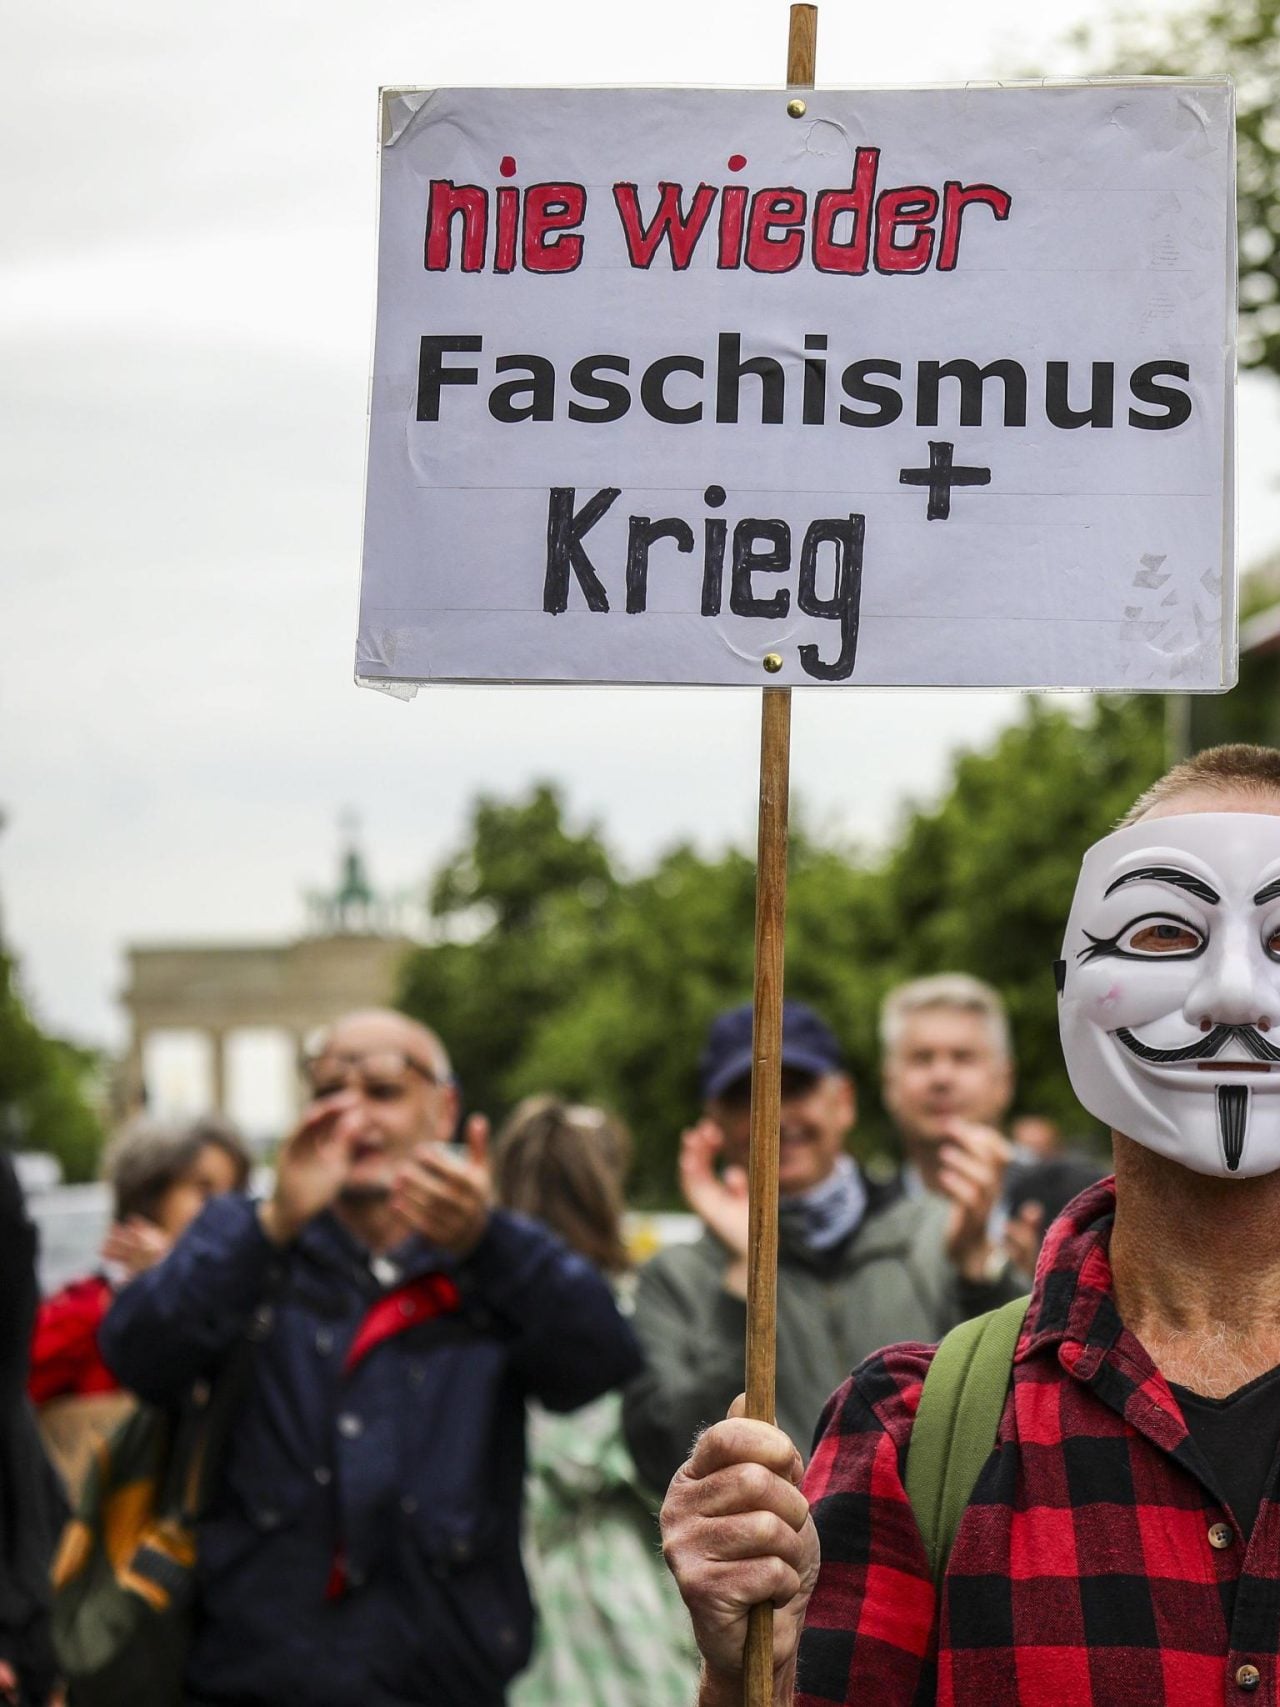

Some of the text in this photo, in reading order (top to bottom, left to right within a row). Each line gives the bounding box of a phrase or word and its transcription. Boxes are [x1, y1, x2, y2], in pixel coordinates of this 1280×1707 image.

[426, 148, 1008, 273] nie wieder
[417, 333, 1191, 430] Faschismus
[900, 441, 991, 520] +
[543, 485, 866, 681] Krieg
